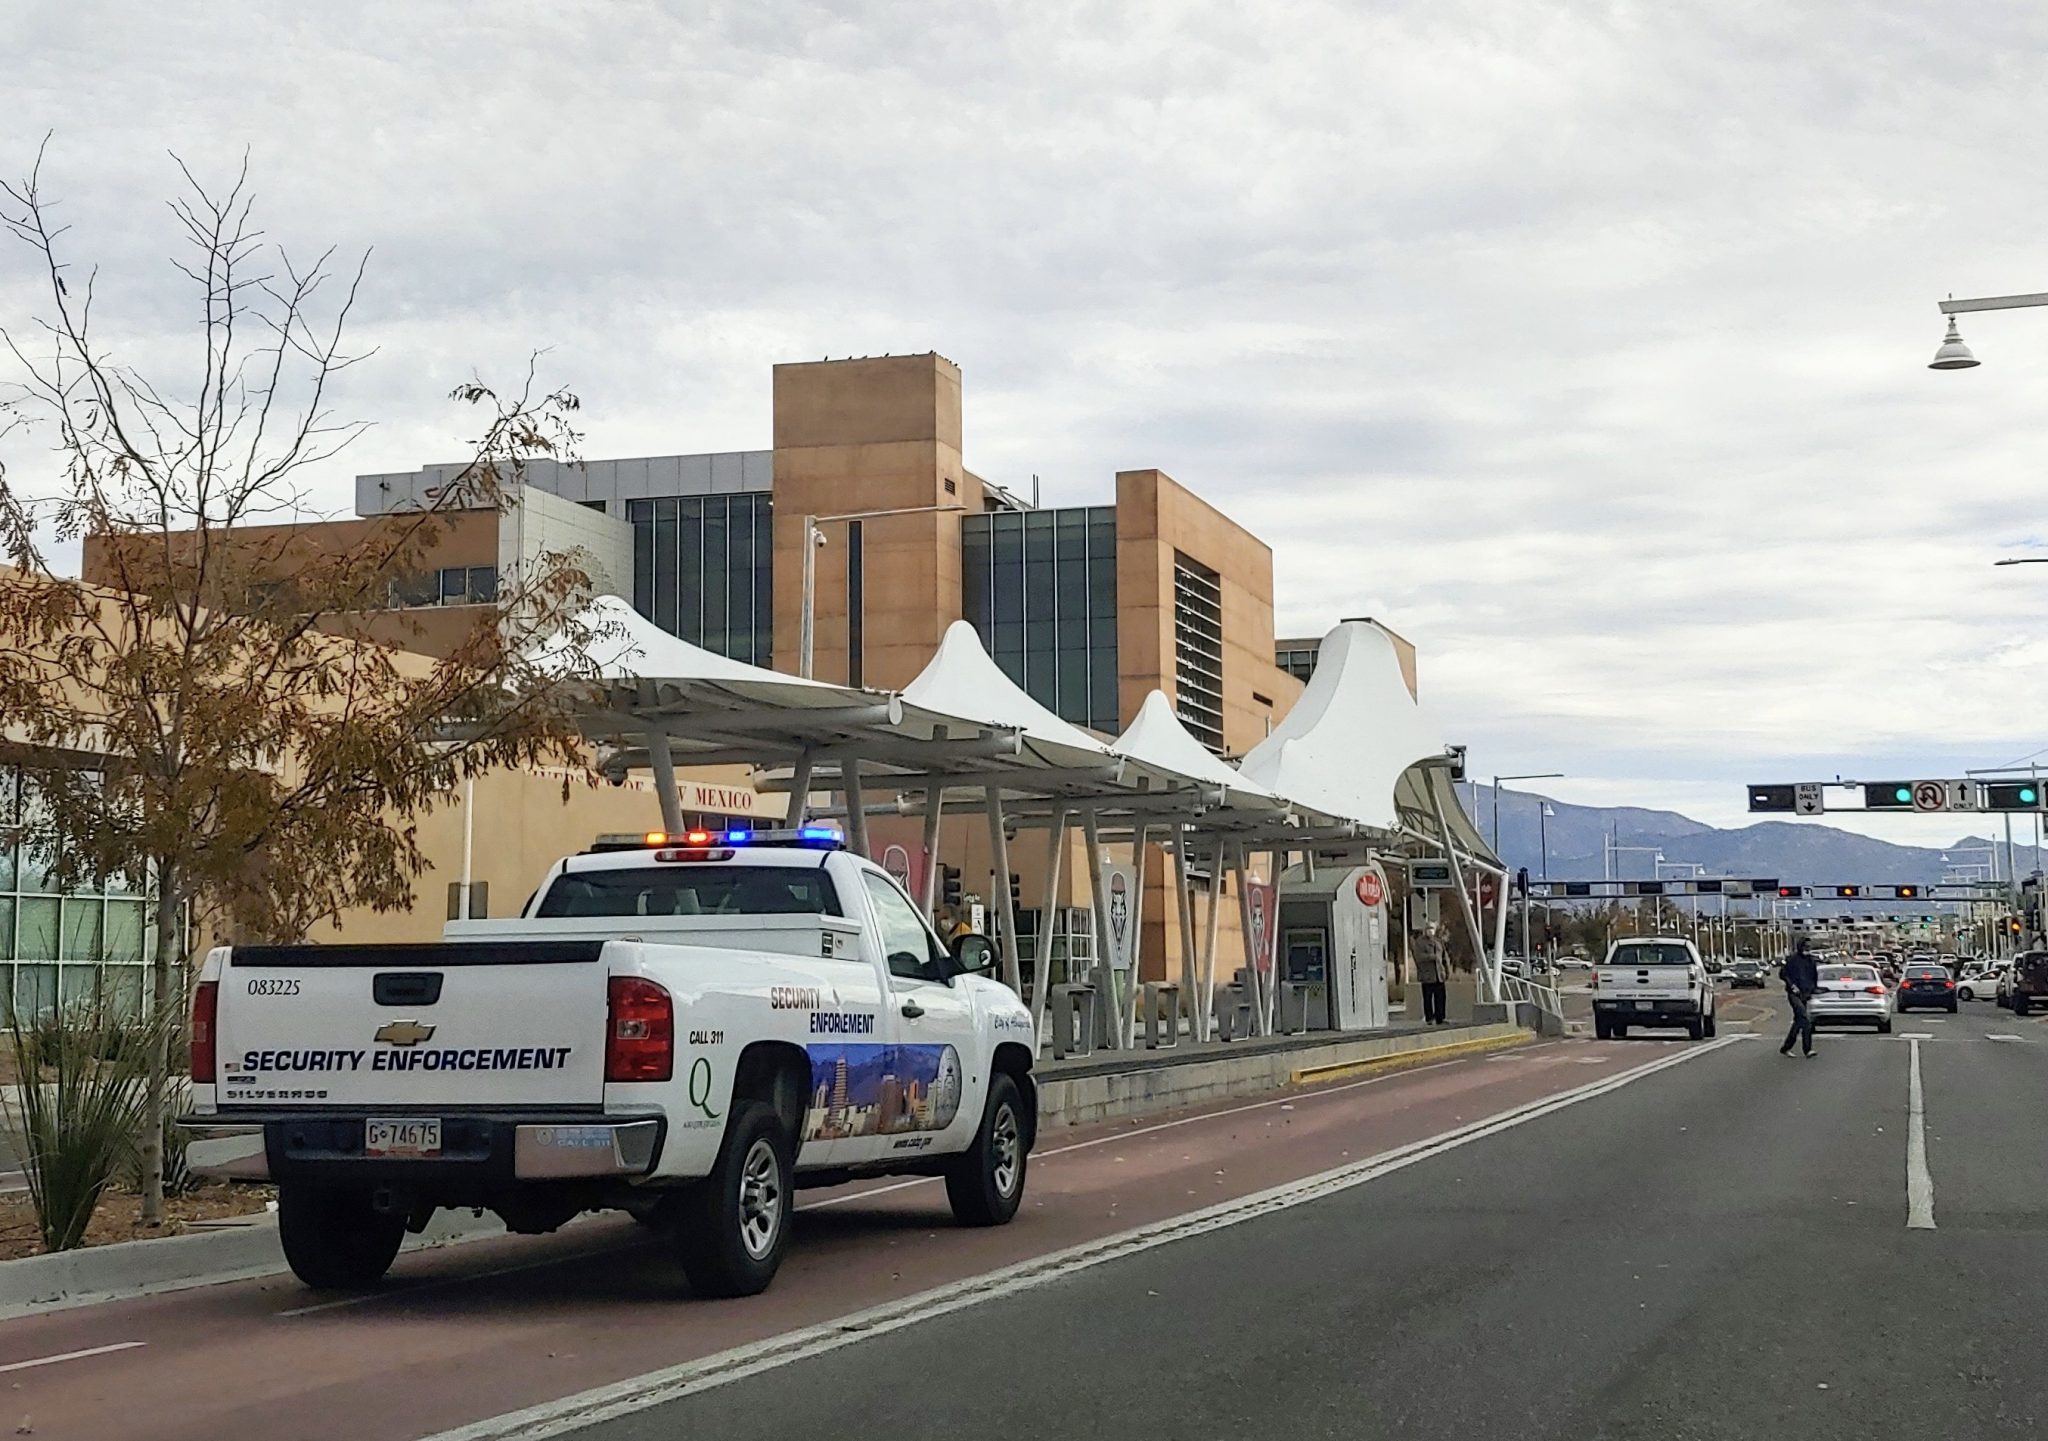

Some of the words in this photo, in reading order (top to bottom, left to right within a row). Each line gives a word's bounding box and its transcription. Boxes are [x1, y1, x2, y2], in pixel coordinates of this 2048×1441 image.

[695, 787, 751, 809] MEXICO
[1798, 793, 1819, 801] ONLY
[1800, 784, 1817, 792] BUS
[247, 978, 301, 996] 083225
[770, 986, 820, 1010] SECURITY
[689, 1031, 709, 1045] CALL
[710, 1030, 724, 1044] 311
[242, 1050, 364, 1072] SECURITY
[371, 1048, 572, 1071] ENFORCEMENT
[688, 1057, 722, 1119] Q
